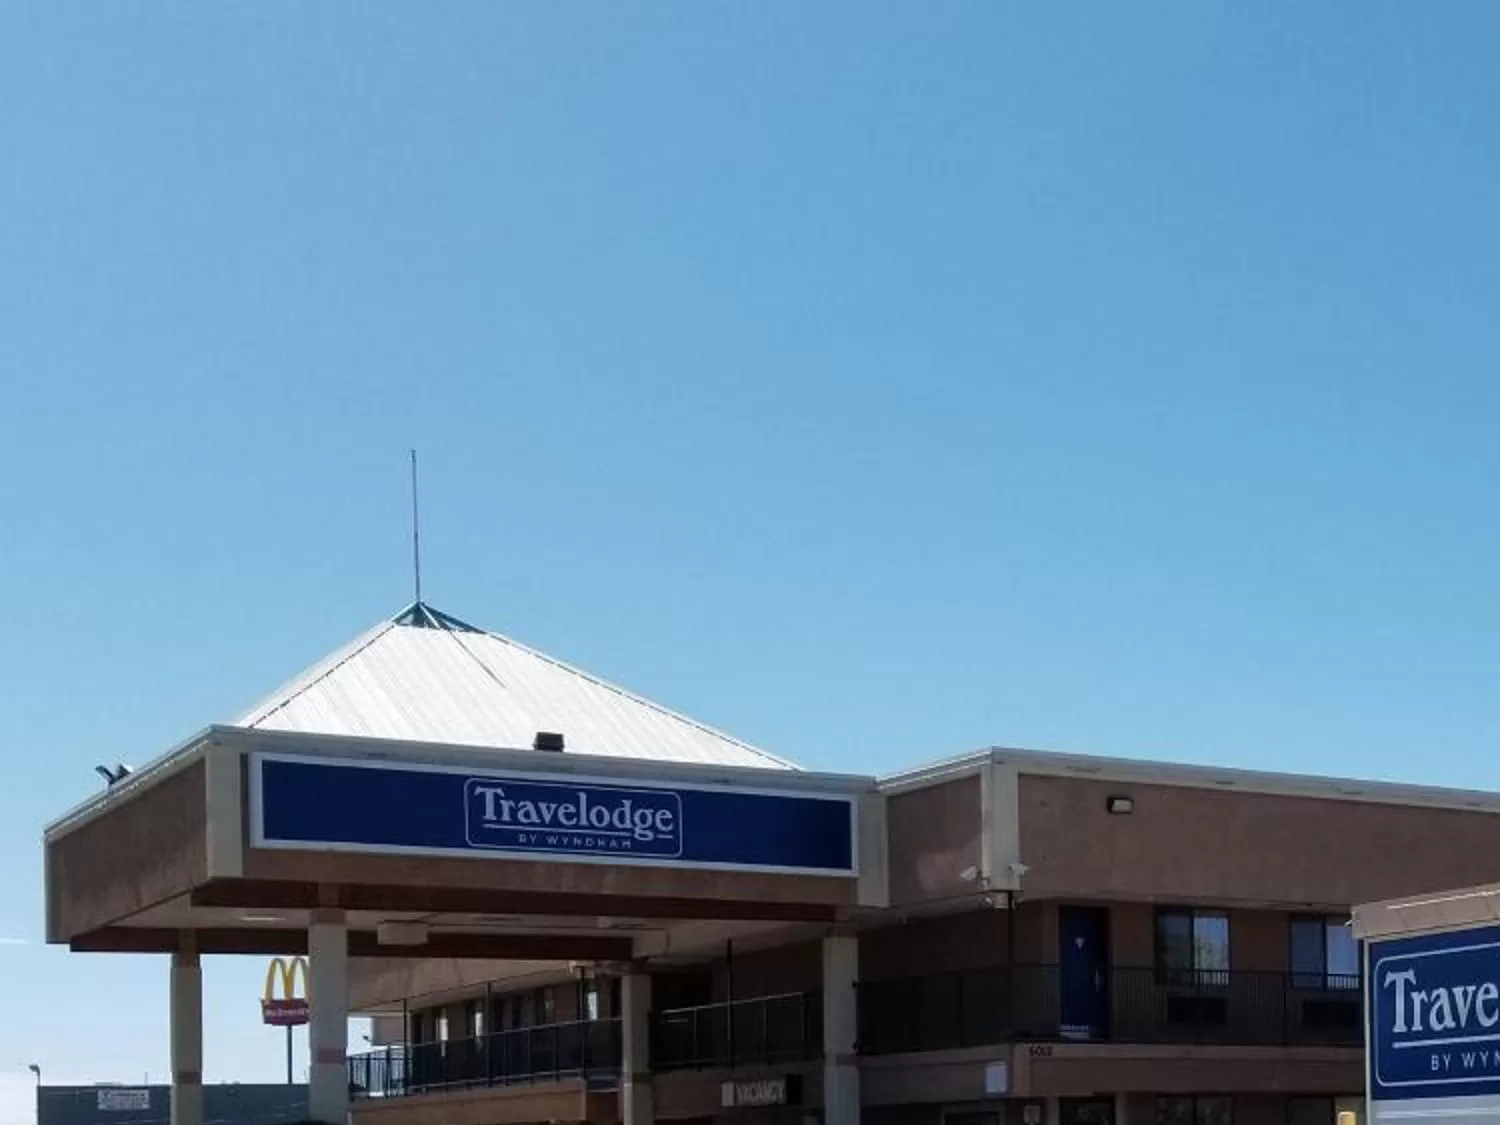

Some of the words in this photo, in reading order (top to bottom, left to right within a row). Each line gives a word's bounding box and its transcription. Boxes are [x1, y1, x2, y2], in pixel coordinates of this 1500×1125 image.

[474, 786, 674, 841] Travelodge
[518, 833, 536, 844] BY
[546, 835, 632, 849] WYNDHAM
[1430, 1053, 1451, 1072] BY
